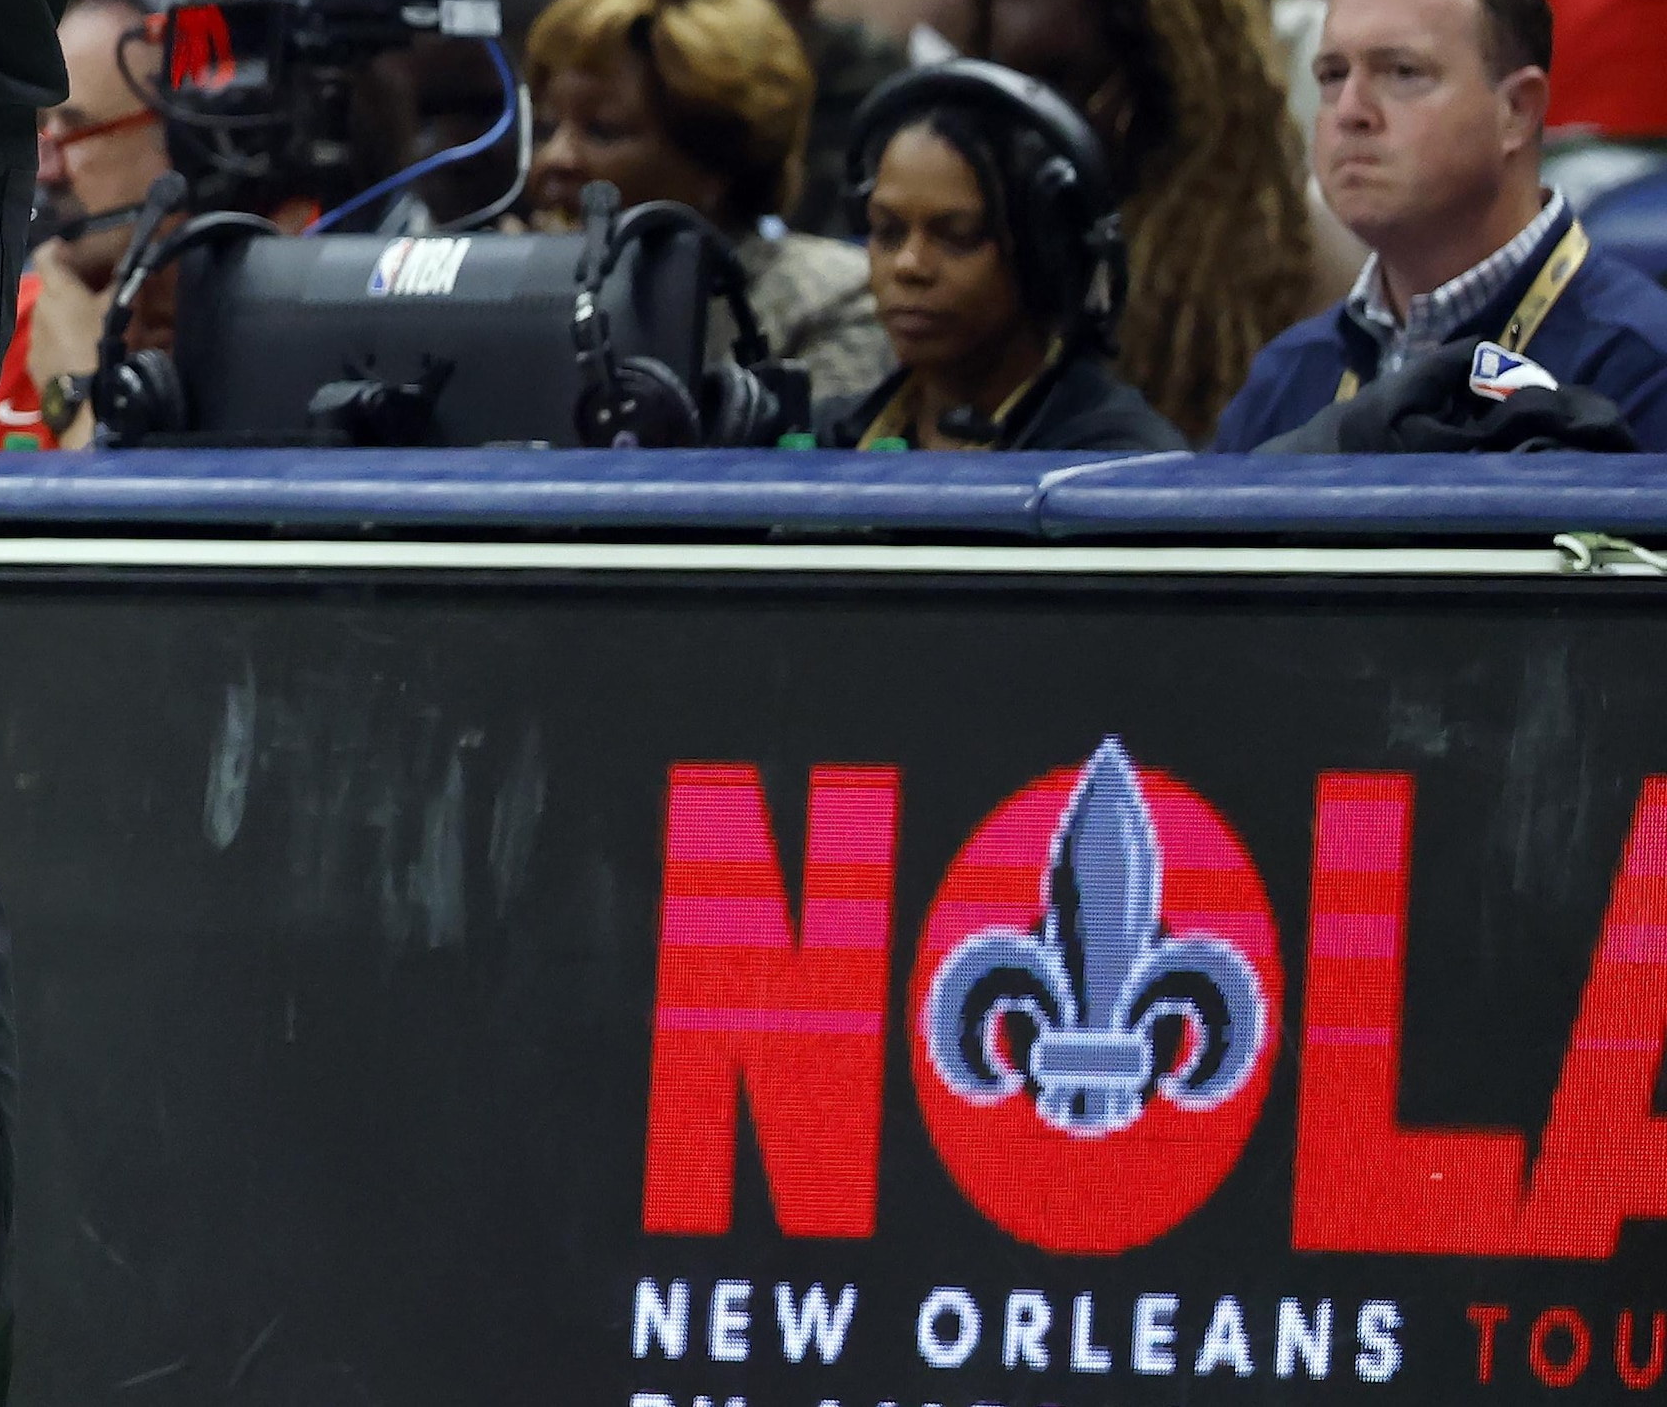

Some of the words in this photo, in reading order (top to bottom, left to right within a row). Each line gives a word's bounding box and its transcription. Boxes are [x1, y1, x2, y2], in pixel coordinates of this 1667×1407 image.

[394, 237, 472, 296] NBA
[632, 1276, 857, 1364] NEW
[917, 1286, 1403, 1383] ORLEANS
[1467, 1304, 1667, 1389] TOU
